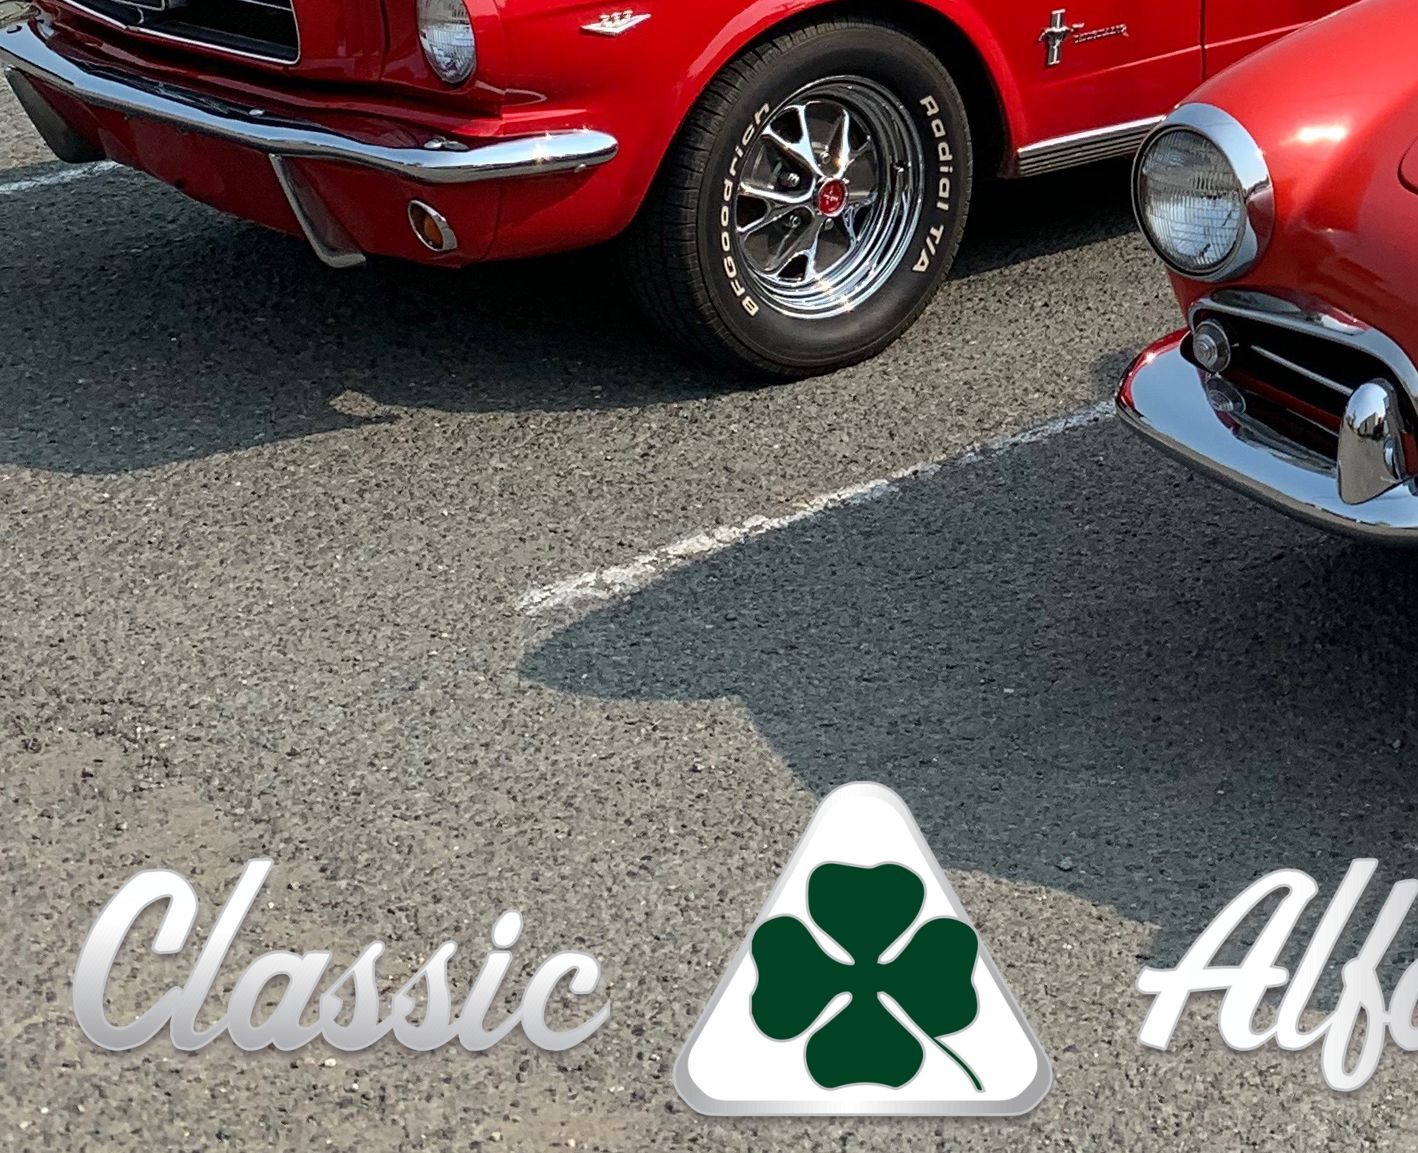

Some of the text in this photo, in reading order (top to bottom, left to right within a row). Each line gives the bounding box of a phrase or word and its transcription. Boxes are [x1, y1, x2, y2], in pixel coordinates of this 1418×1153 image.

[720, 102, 770, 317] BFGoodrich
[911, 95, 953, 273] Radial T/A
